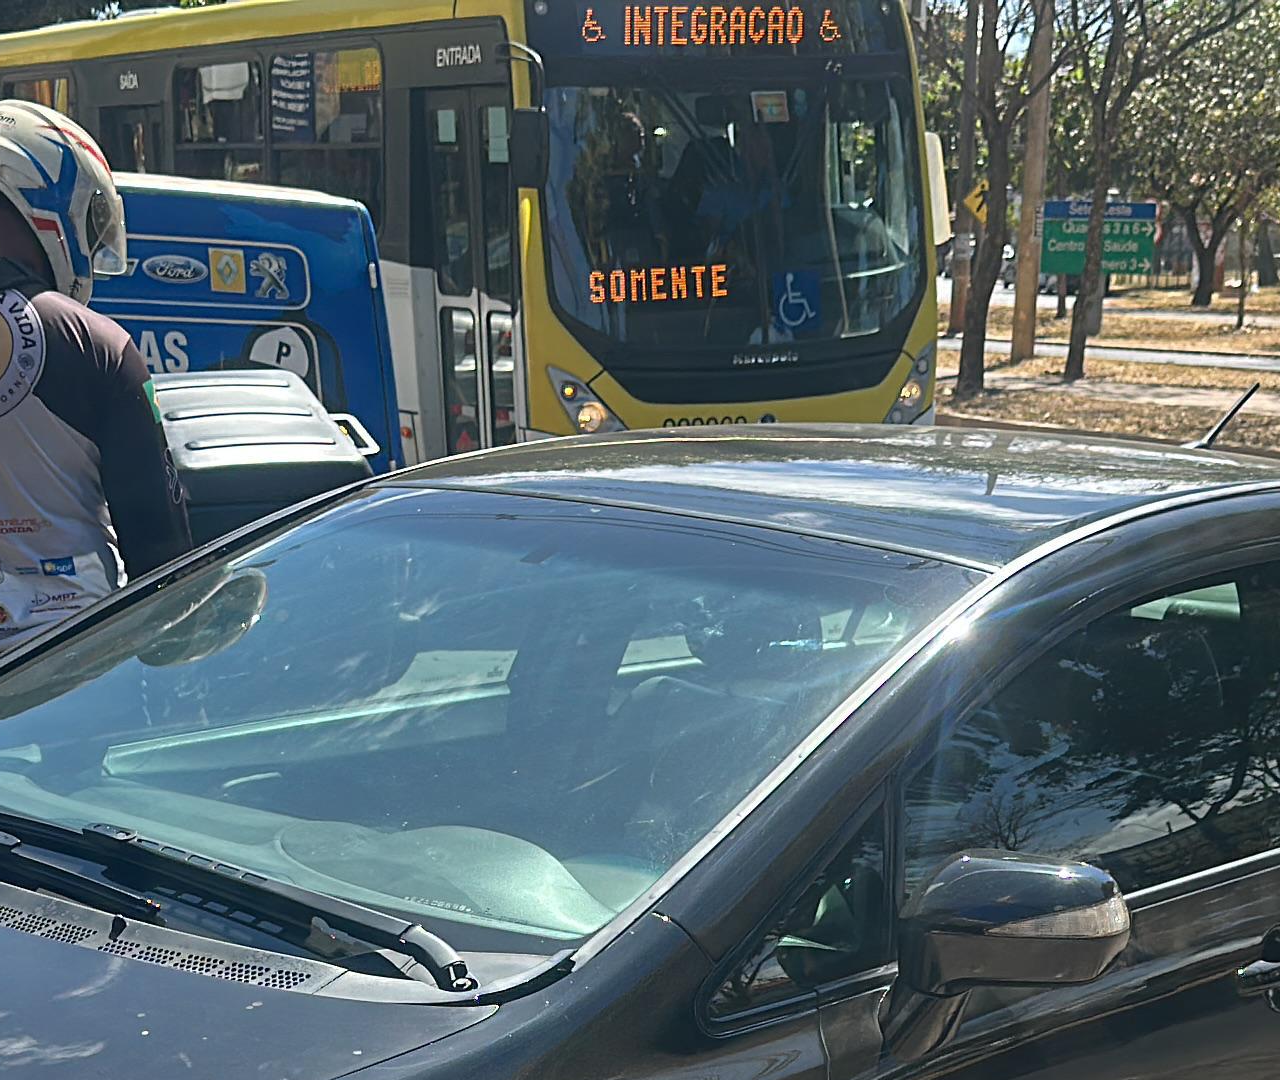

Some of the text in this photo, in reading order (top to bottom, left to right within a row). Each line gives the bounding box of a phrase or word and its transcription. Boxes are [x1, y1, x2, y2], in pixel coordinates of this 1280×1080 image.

[623, 5, 803, 45] INTEGRACAO
[436, 45, 481, 67] ENTRADA
[1047, 239, 1085, 252] Centro
[154, 260, 195, 279] Ford
[589, 264, 728, 303] SOMENTE
[9, 302, 37, 349] VIDA
[276, 341, 291, 364] P
